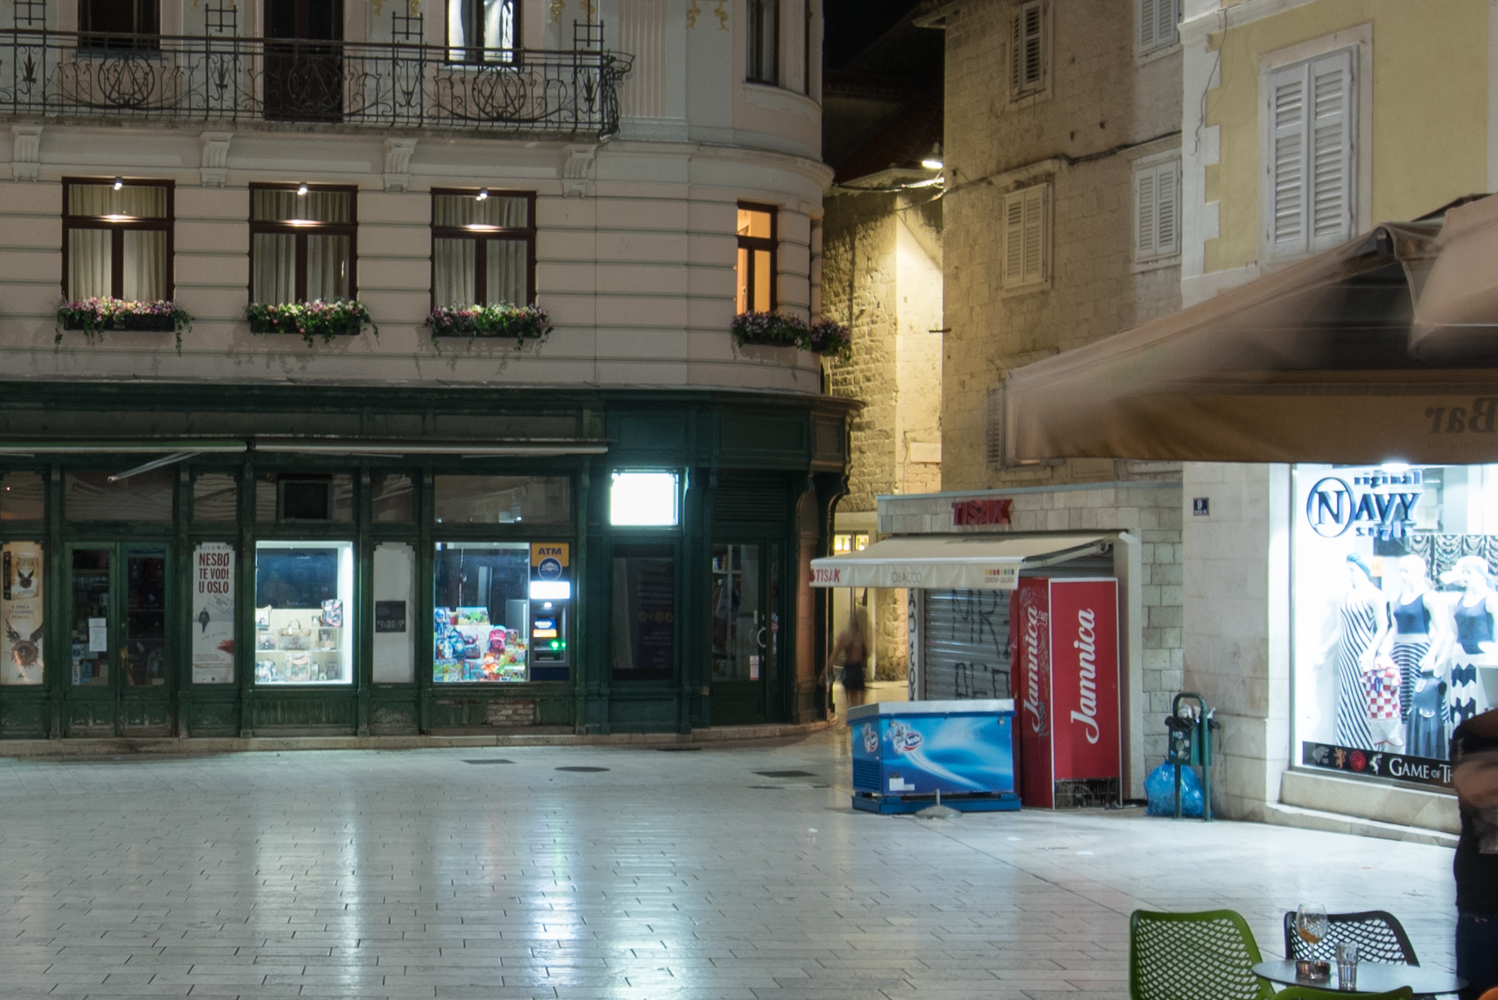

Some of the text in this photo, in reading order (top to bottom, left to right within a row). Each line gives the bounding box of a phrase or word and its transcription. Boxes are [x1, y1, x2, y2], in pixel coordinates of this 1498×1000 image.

[951, 499, 1013, 526] TISAK
[1315, 490, 1422, 525] NAVY
[198, 552, 230, 567] NESBØ
[538, 547, 562, 556] ATM
[199, 568, 208, 580] TE
[816, 568, 841, 583] TISAK
[198, 581, 229, 594] U OSLO
[1023, 605, 1040, 733] Jamnica
[1071, 608, 1100, 745] Jamnica
[1388, 757, 1430, 779] GAME
